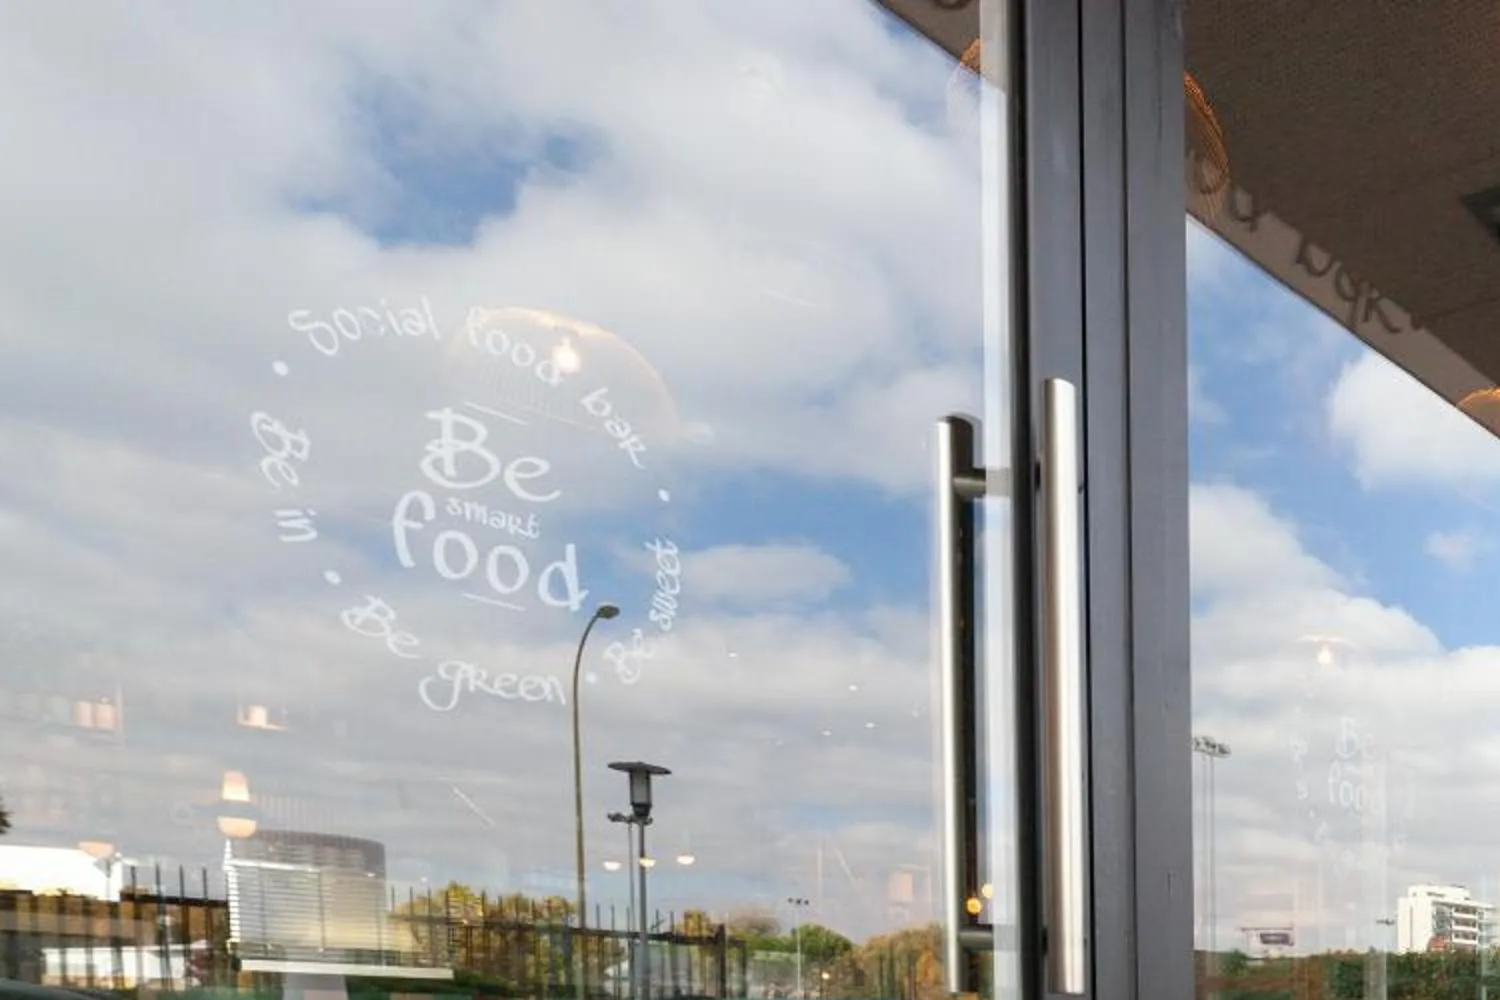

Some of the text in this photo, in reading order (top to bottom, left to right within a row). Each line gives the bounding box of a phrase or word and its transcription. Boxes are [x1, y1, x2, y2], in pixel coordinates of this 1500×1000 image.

[288, 296, 441, 356] Social
[420, 407, 561, 502] Be
[392, 490, 589, 612] food
[645, 538, 681, 632] sweet
[341, 594, 422, 659] Be
